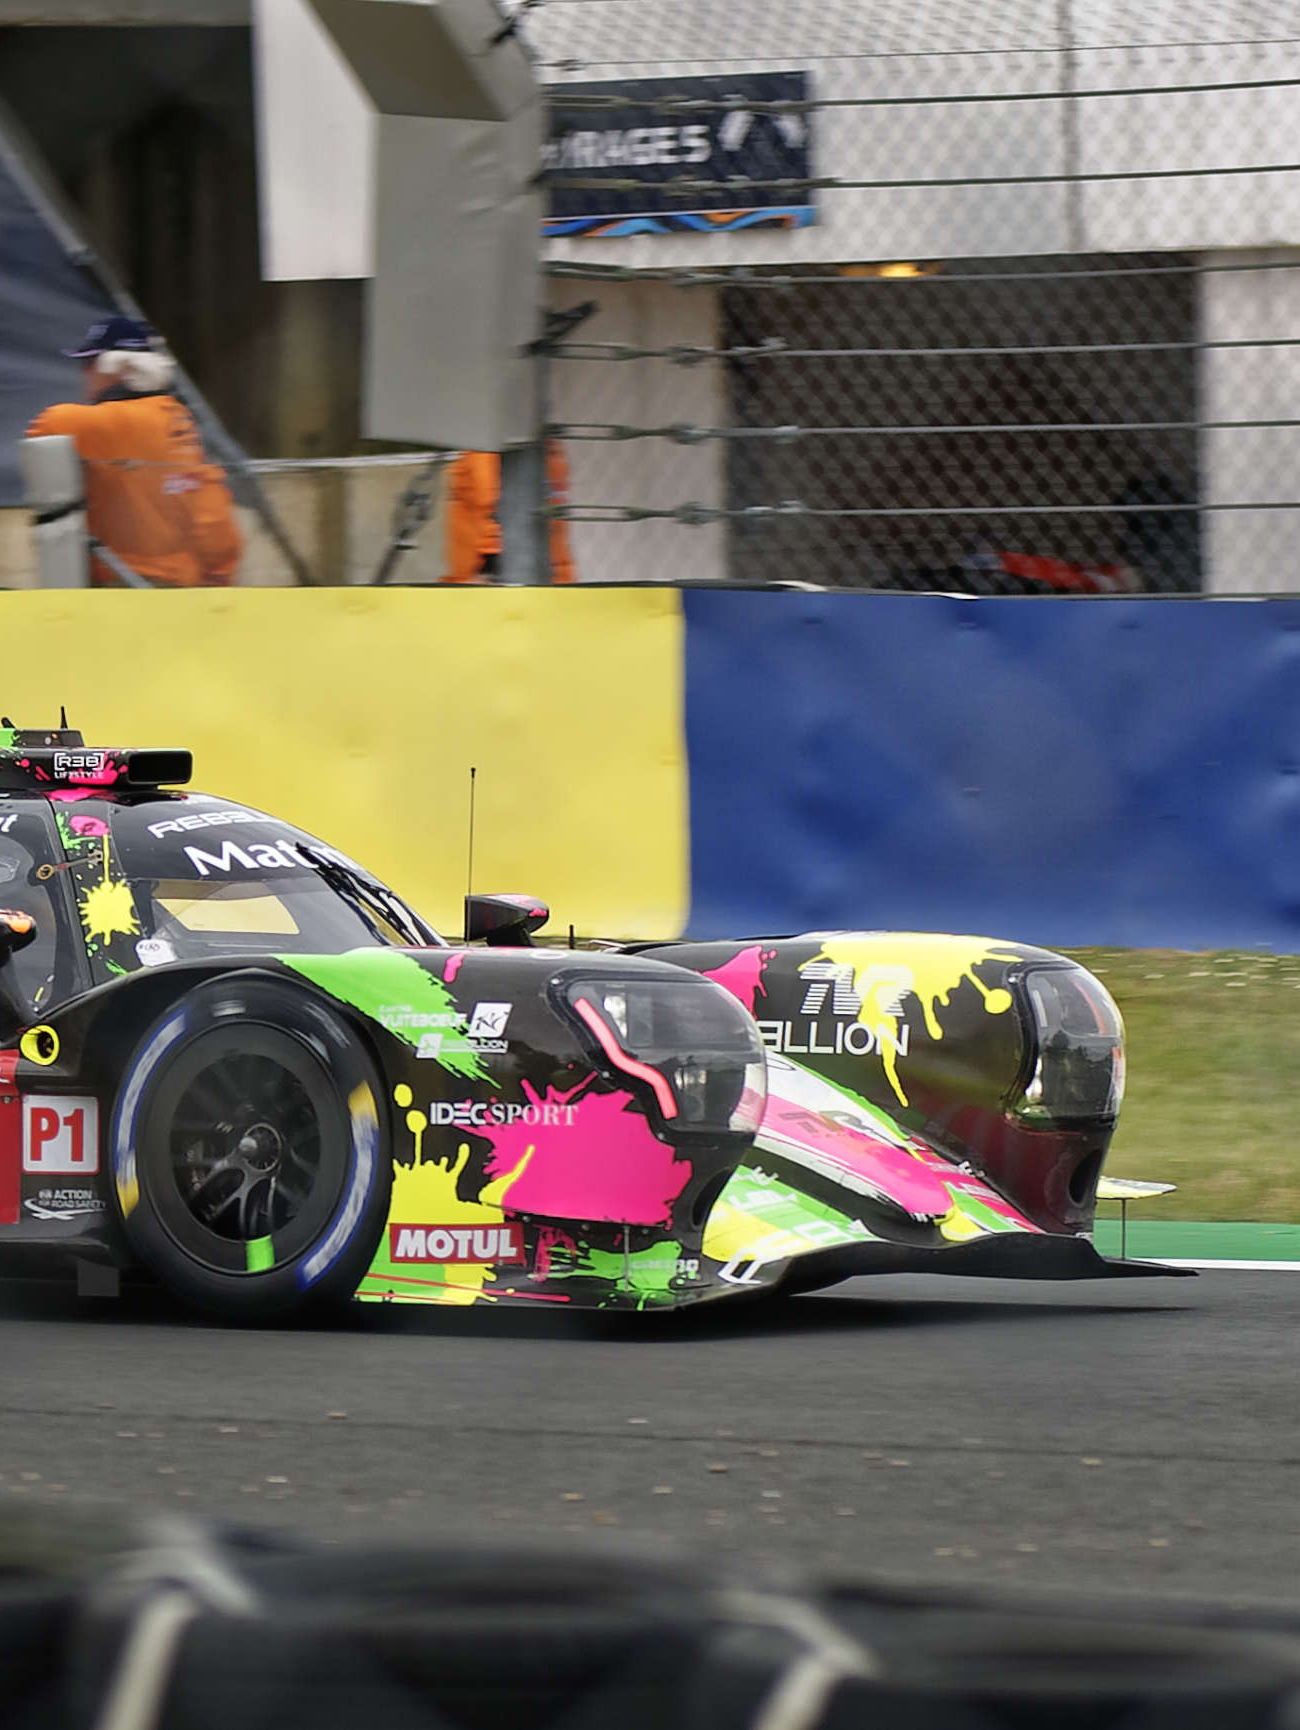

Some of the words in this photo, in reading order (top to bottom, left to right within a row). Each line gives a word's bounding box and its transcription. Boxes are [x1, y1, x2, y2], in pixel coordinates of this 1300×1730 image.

[430, 1102, 488, 1125] IDEC
[491, 1103, 579, 1127] SPORT
[30, 1107, 84, 1162] P1
[54, 1189, 93, 1200] ACTION
[395, 1229, 518, 1259] MOTUL
